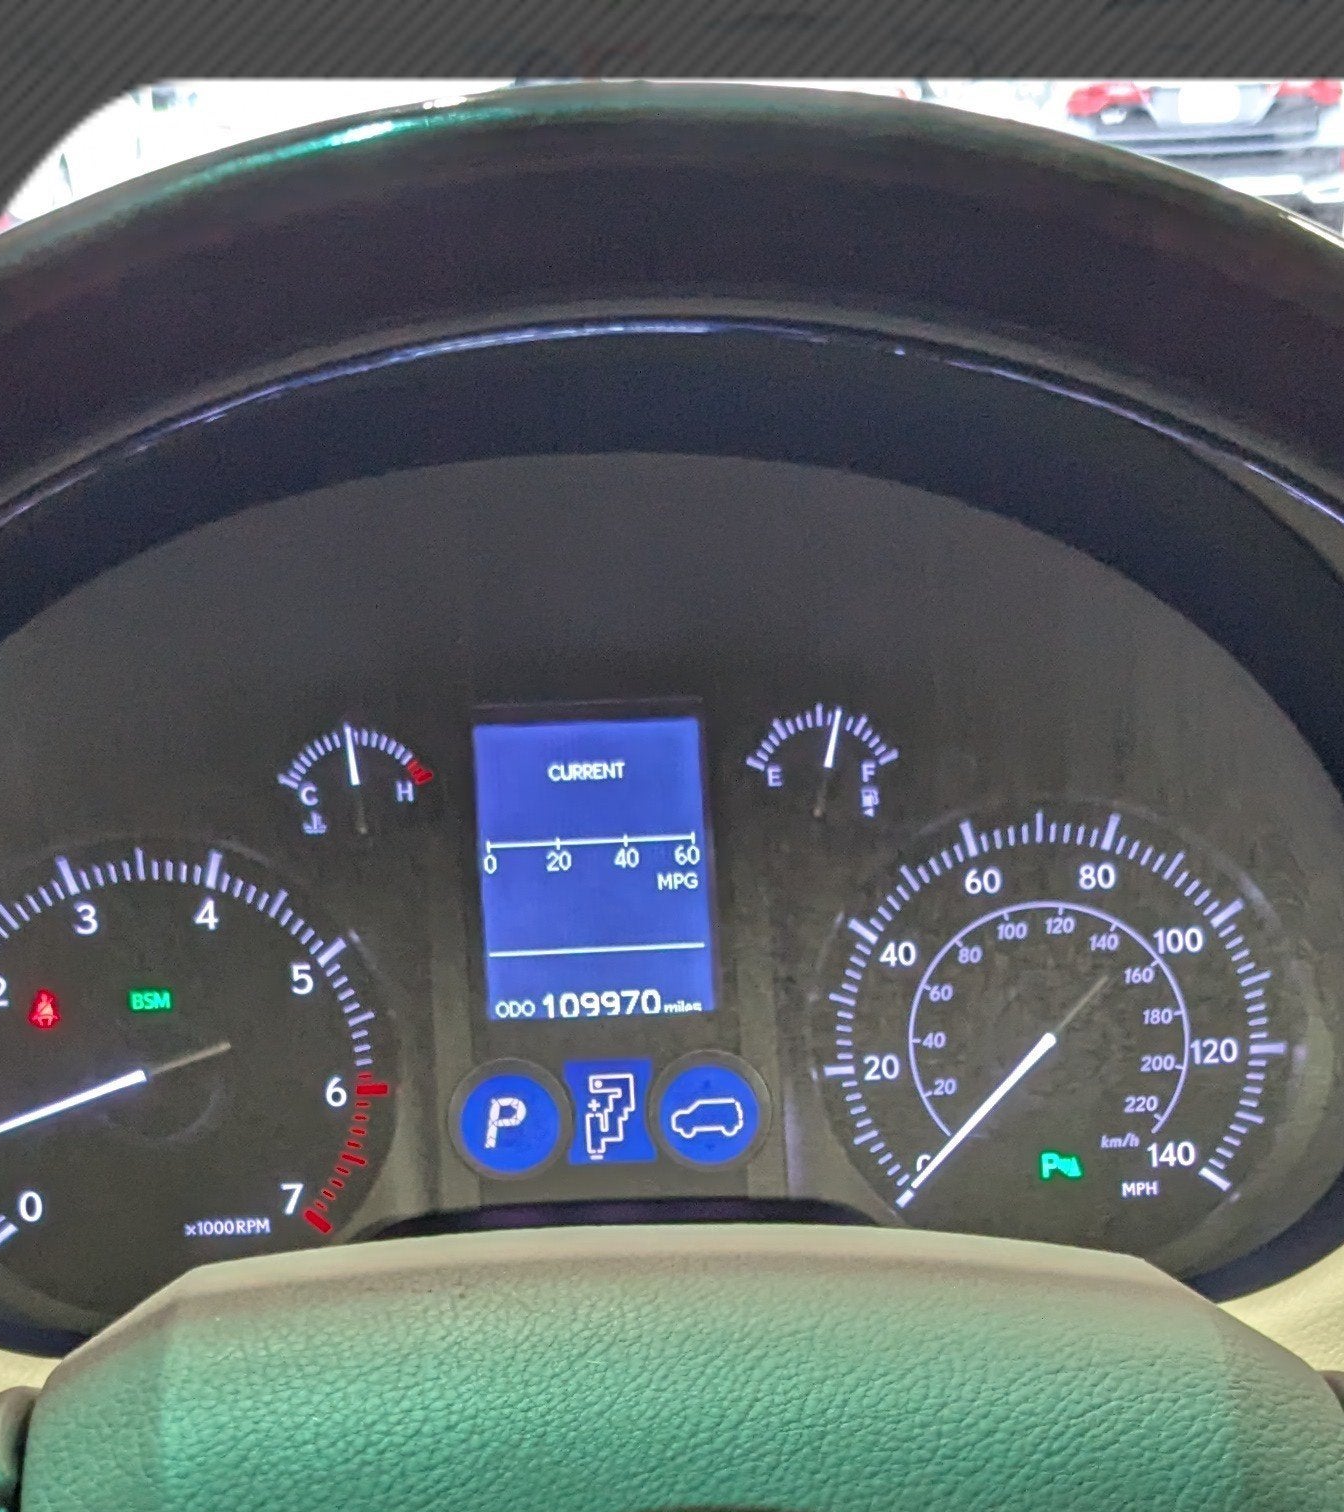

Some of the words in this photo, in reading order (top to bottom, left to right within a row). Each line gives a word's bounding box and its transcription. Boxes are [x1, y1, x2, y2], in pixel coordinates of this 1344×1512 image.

[548, 760, 626, 782] CURRENT
[767, 765, 783, 787] E
[861, 761, 876, 783] F
[300, 786, 319, 806] C
[397, 780, 414, 803] H
[484, 853, 497, 876] 0
[546, 850, 572, 873] 20
[613, 848, 640, 870] 40
[674, 845, 701, 867] 60
[657, 872, 699, 892] MPG
[964, 866, 1002, 894] 60
[1078, 863, 1116, 890] 80
[77, 903, 99, 936] 3
[194, 900, 219, 932] 4
[1045, 916, 1075, 936] 120
[996, 921, 1028, 942] 100
[1156, 927, 1204, 955] 100
[879, 938, 917, 967] 40
[1089, 934, 1119, 953] 140
[958, 945, 982, 965] 80
[291, 964, 315, 998] 5
[1124, 966, 1154, 985] 160
[131, 992, 172, 1011] BSM
[495, 1000, 536, 1018] ODO
[543, 989, 662, 1019] 109970
[664, 1001, 702, 1014] miles
[929, 983, 953, 1003] 60
[1143, 1006, 1173, 1025] 180
[923, 1031, 946, 1050] 40
[1191, 1037, 1238, 1066] 120
[864, 1053, 900, 1083] 20
[1140, 1054, 1175, 1073] 200
[325, 1076, 349, 1107] 6
[933, 1078, 956, 1096] 20
[1124, 1095, 1158, 1114] 220
[1101, 1133, 1140, 1151] km/h
[1148, 1141, 1196, 1169] 140
[281, 1183, 304, 1214] 7
[1123, 1181, 1157, 1197] MPH
[18, 1190, 43, 1222] 0
